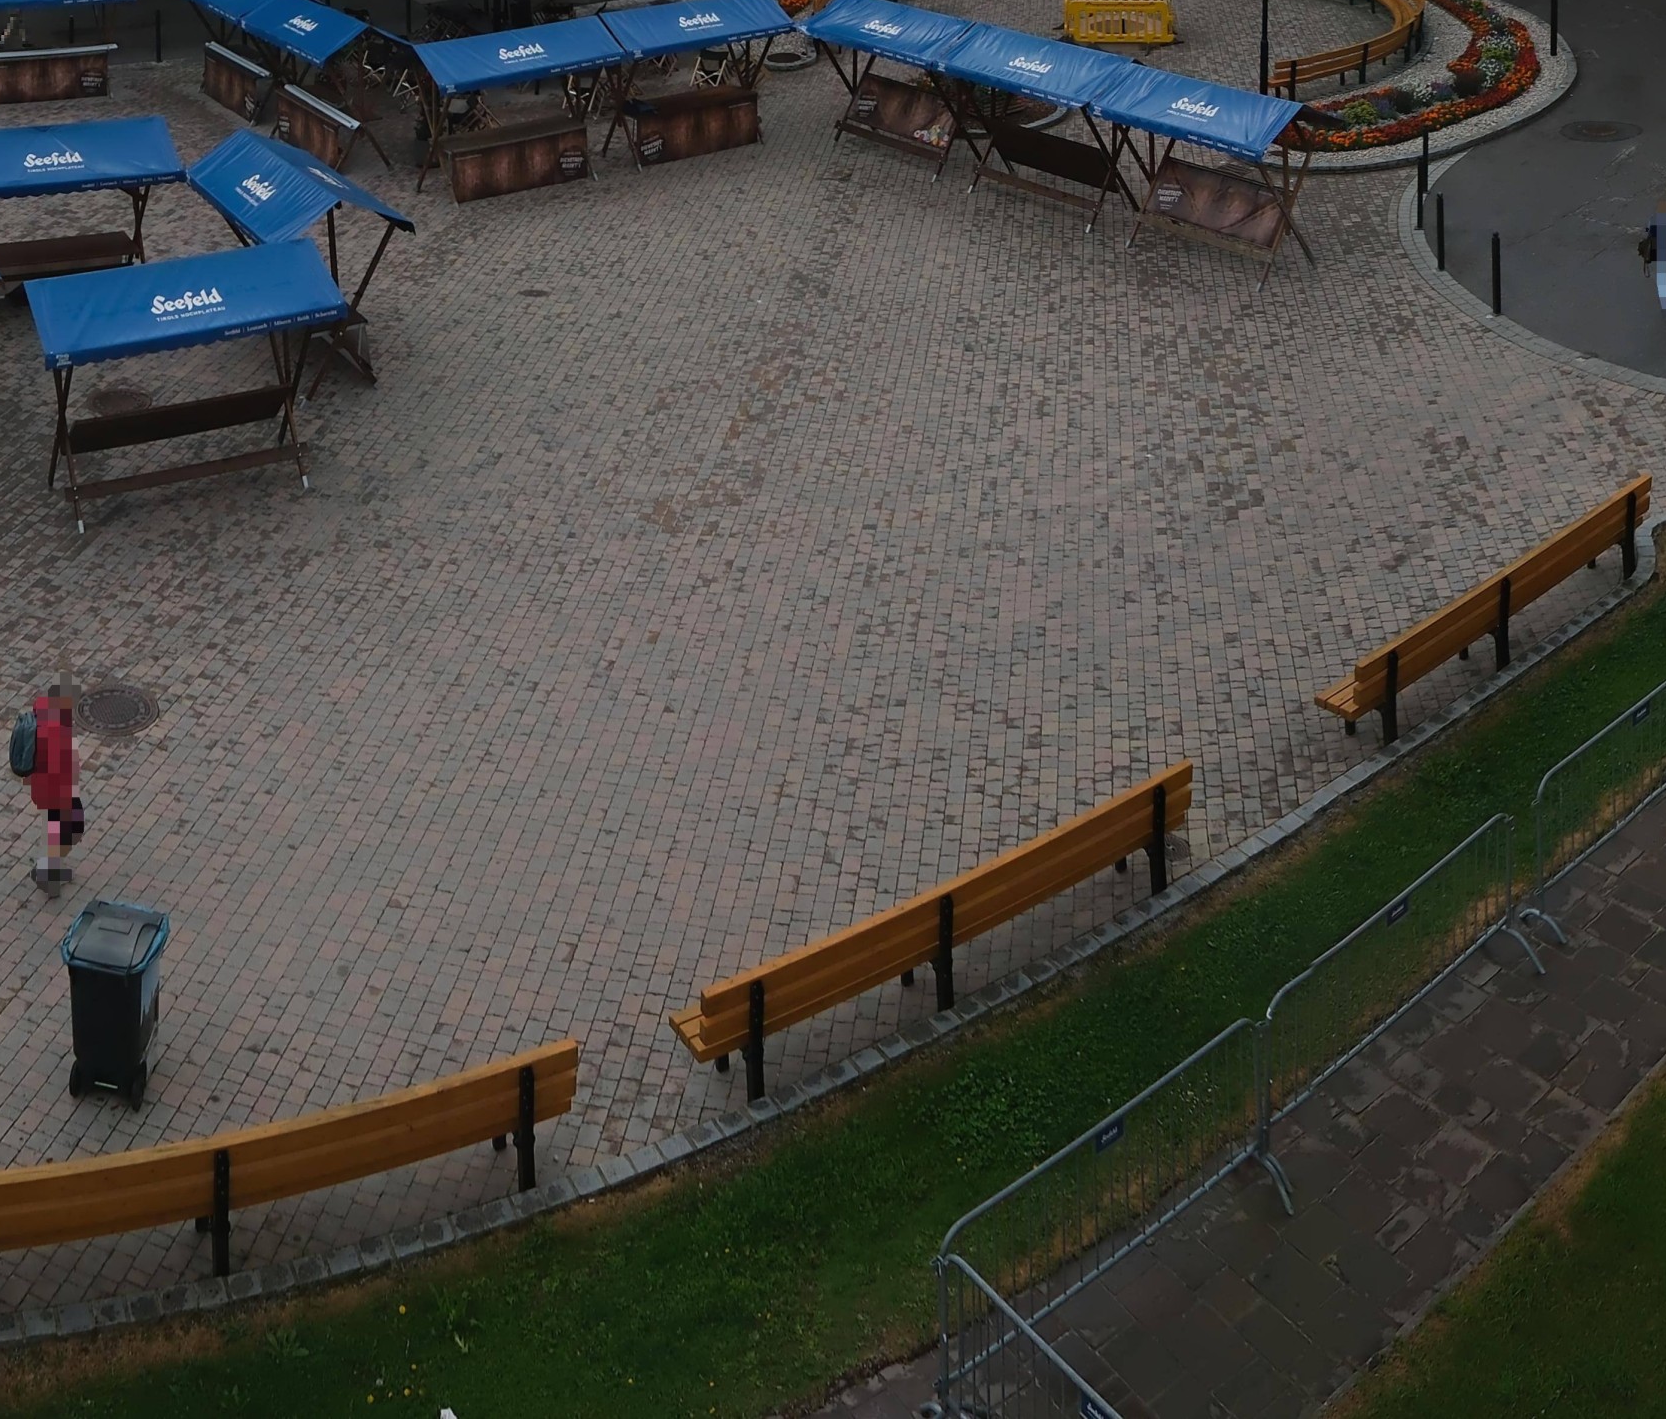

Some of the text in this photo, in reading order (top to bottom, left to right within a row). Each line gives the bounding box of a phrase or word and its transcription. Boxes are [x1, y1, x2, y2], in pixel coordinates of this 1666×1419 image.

[678, 12, 720, 29] Seefeld
[498, 43, 545, 60] Seefeld
[1008, 56, 1053, 73] Seefeld
[1171, 97, 1221, 118] Seefeld
[23, 152, 83, 168] Seefeld
[151, 287, 224, 315] Seefeld
